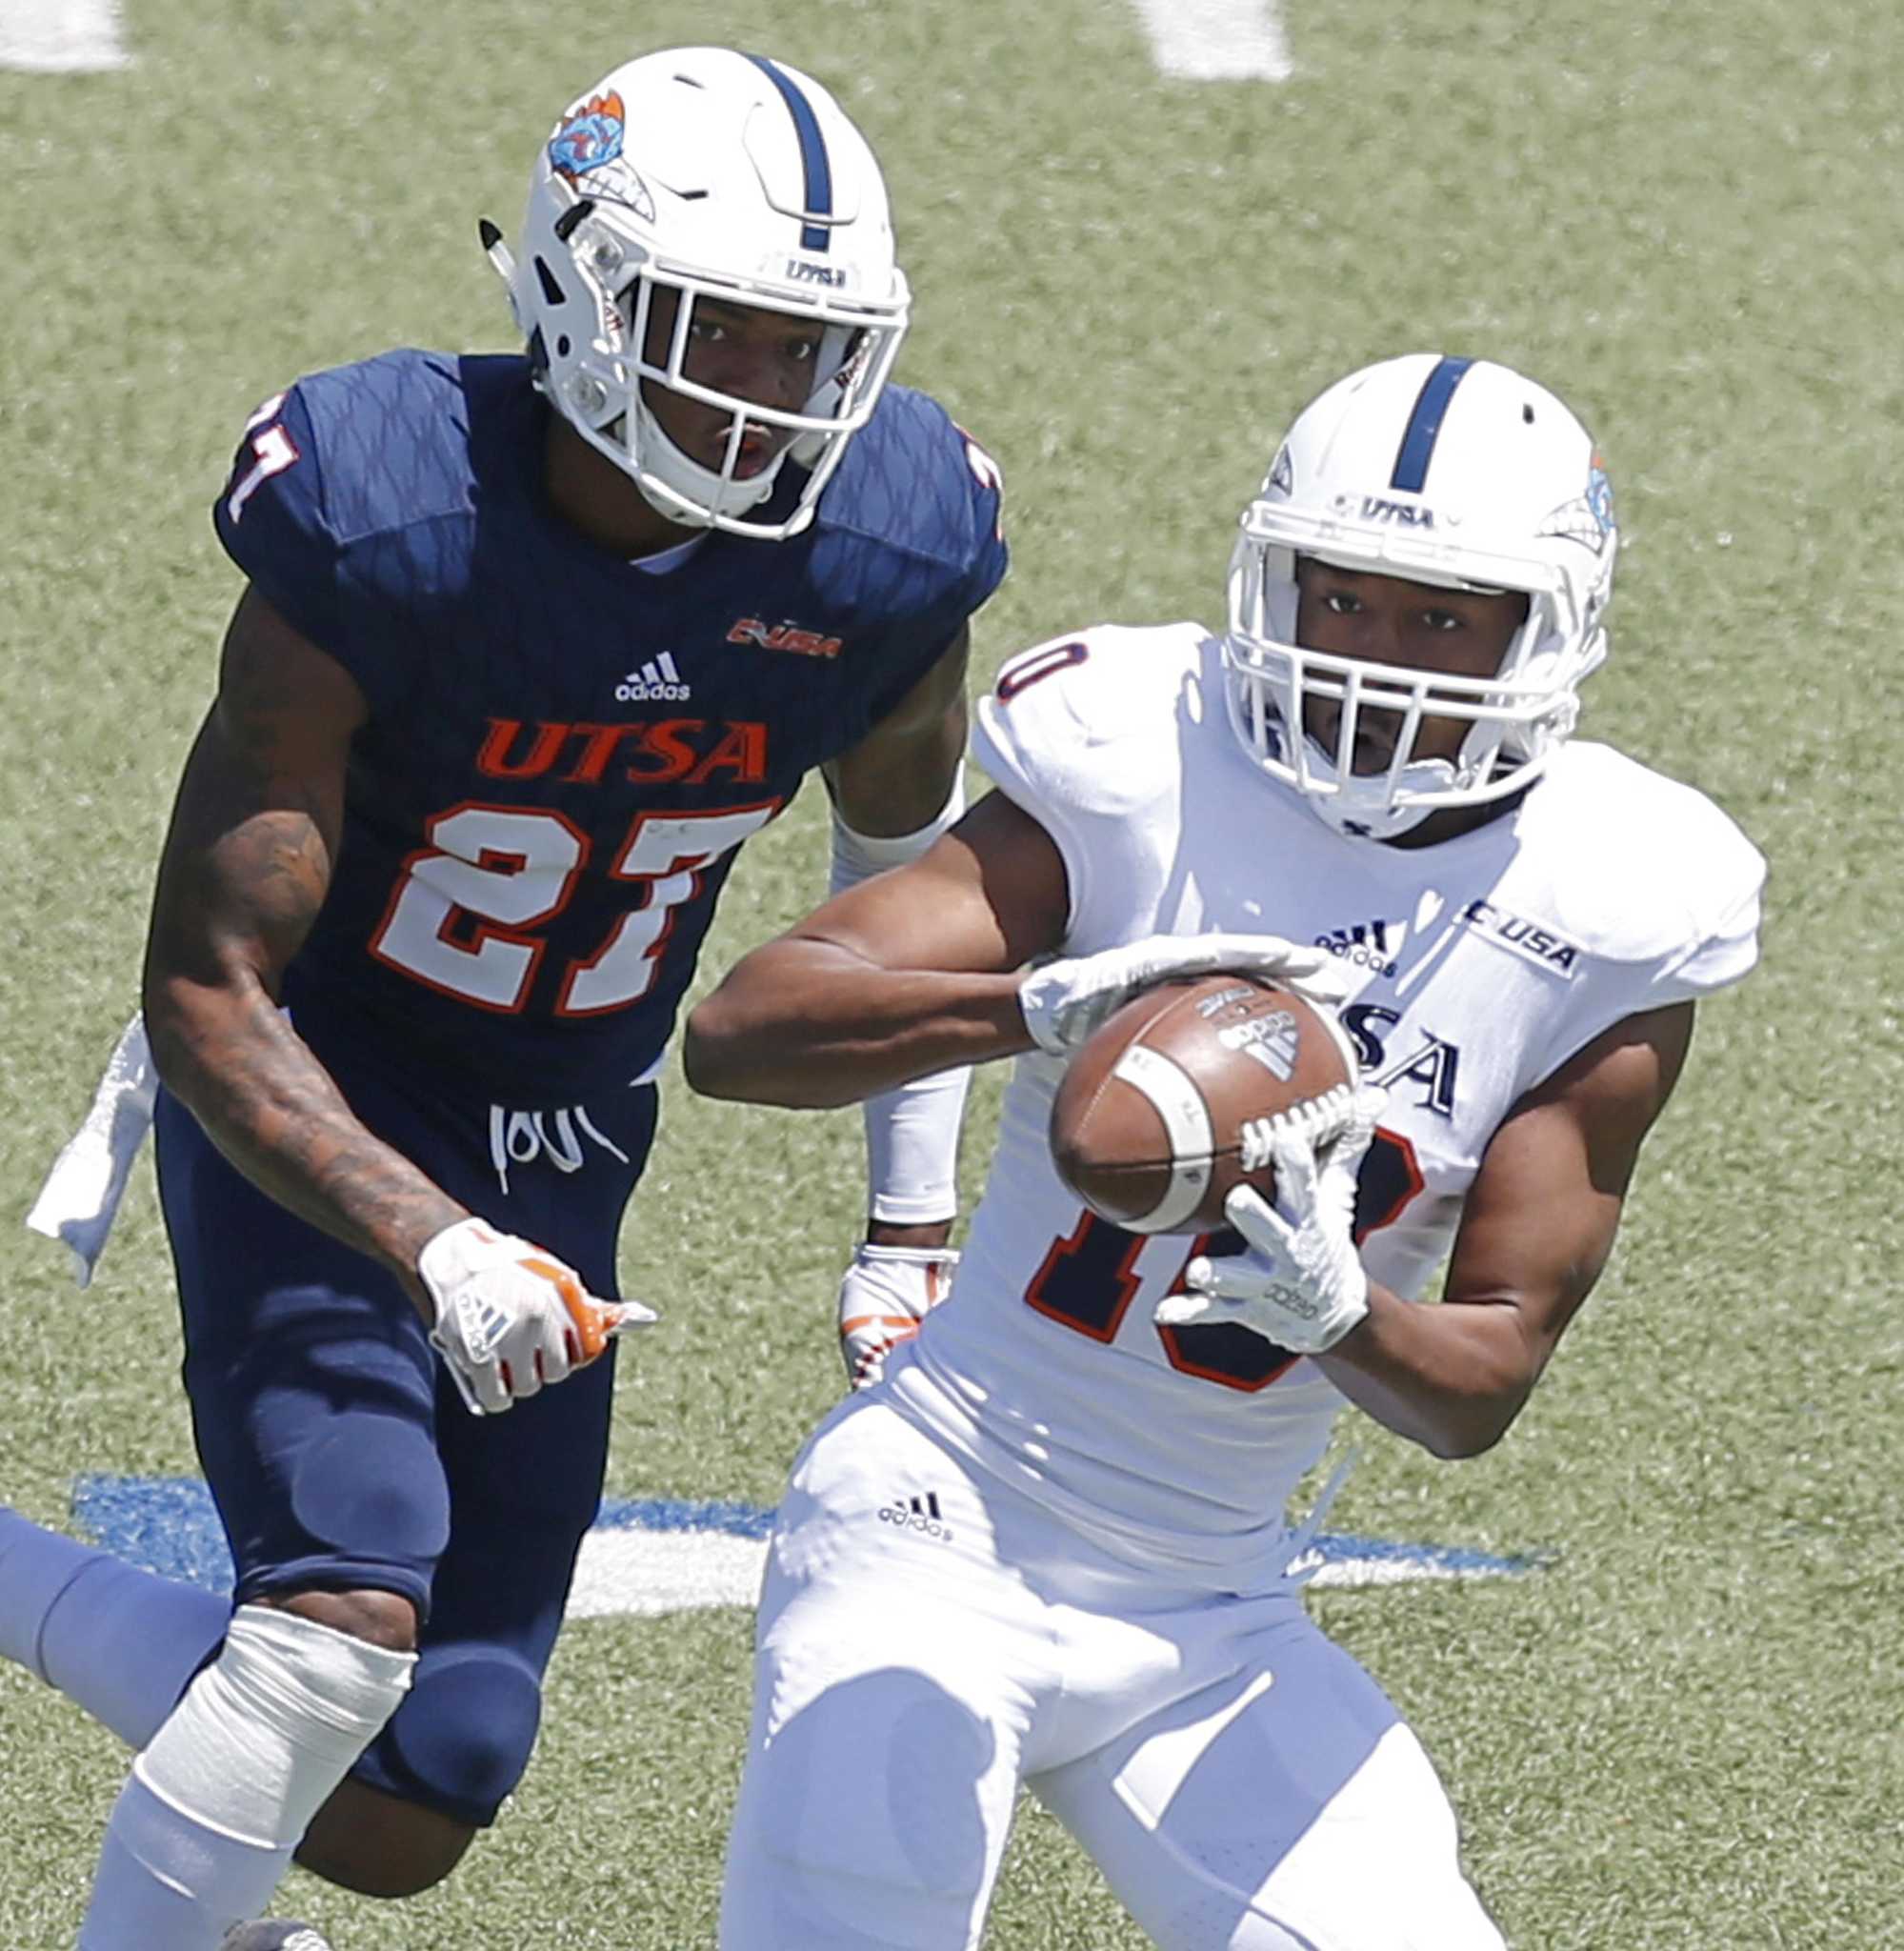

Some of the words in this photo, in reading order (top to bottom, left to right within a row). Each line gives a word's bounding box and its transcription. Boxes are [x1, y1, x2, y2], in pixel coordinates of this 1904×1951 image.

[1359, 495, 1434, 531] UTSA
[614, 680, 691, 702] adidas
[476, 717, 770, 785] UTSA
[368, 794, 786, 1018] 27
[1314, 935, 1397, 978] adidas
[1498, 917, 1580, 970] USA
[877, 1507, 954, 1542] adidas
